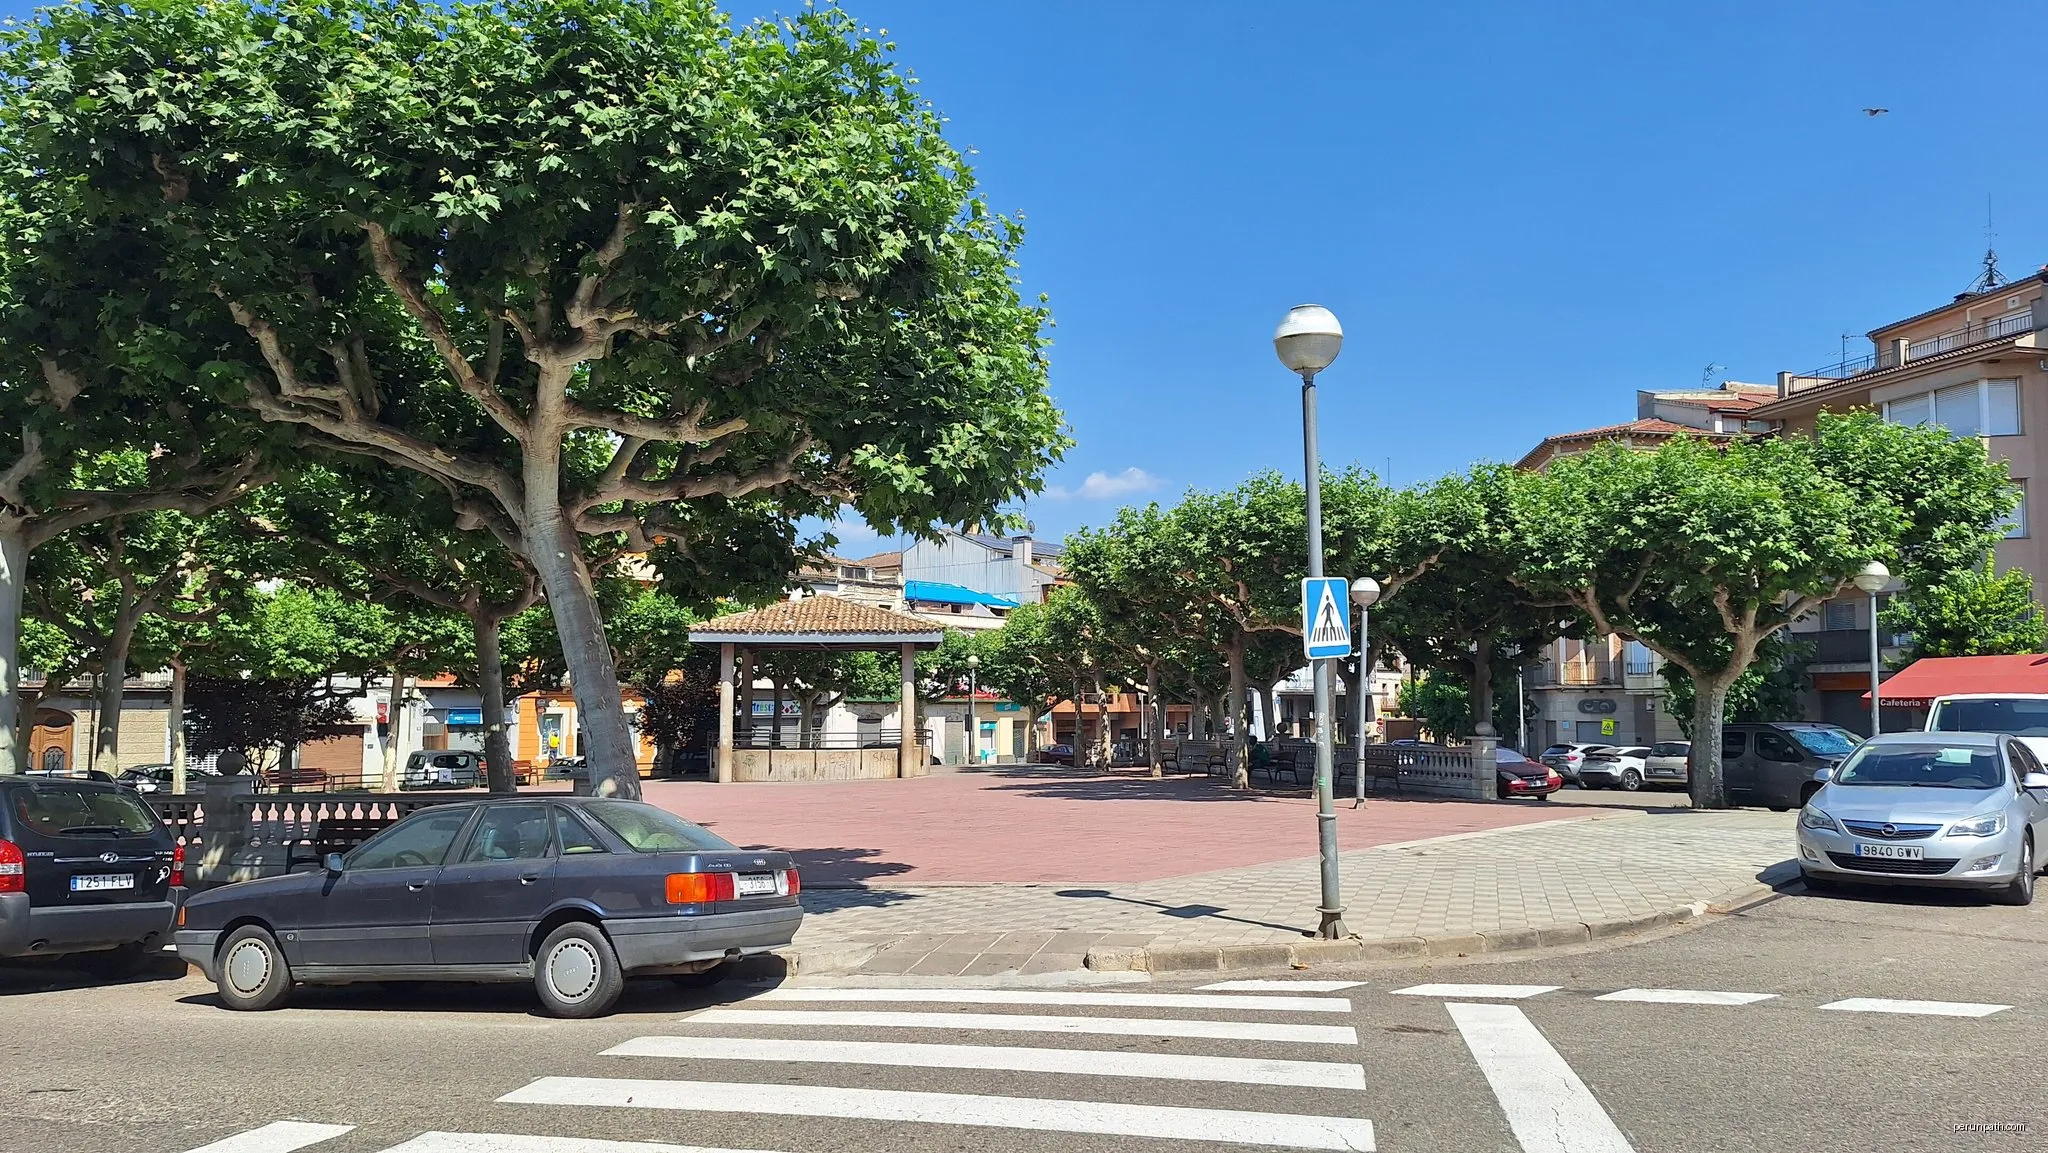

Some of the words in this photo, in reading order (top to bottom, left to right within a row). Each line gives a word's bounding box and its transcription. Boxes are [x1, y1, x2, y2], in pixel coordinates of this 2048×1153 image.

[1880, 699, 1921, 707] Cafeteria
[1863, 845, 1893, 857] 9840
[1897, 847, 1920, 858] GWV
[80, 876, 106, 888] 1251
[111, 875, 132, 887] FLV
